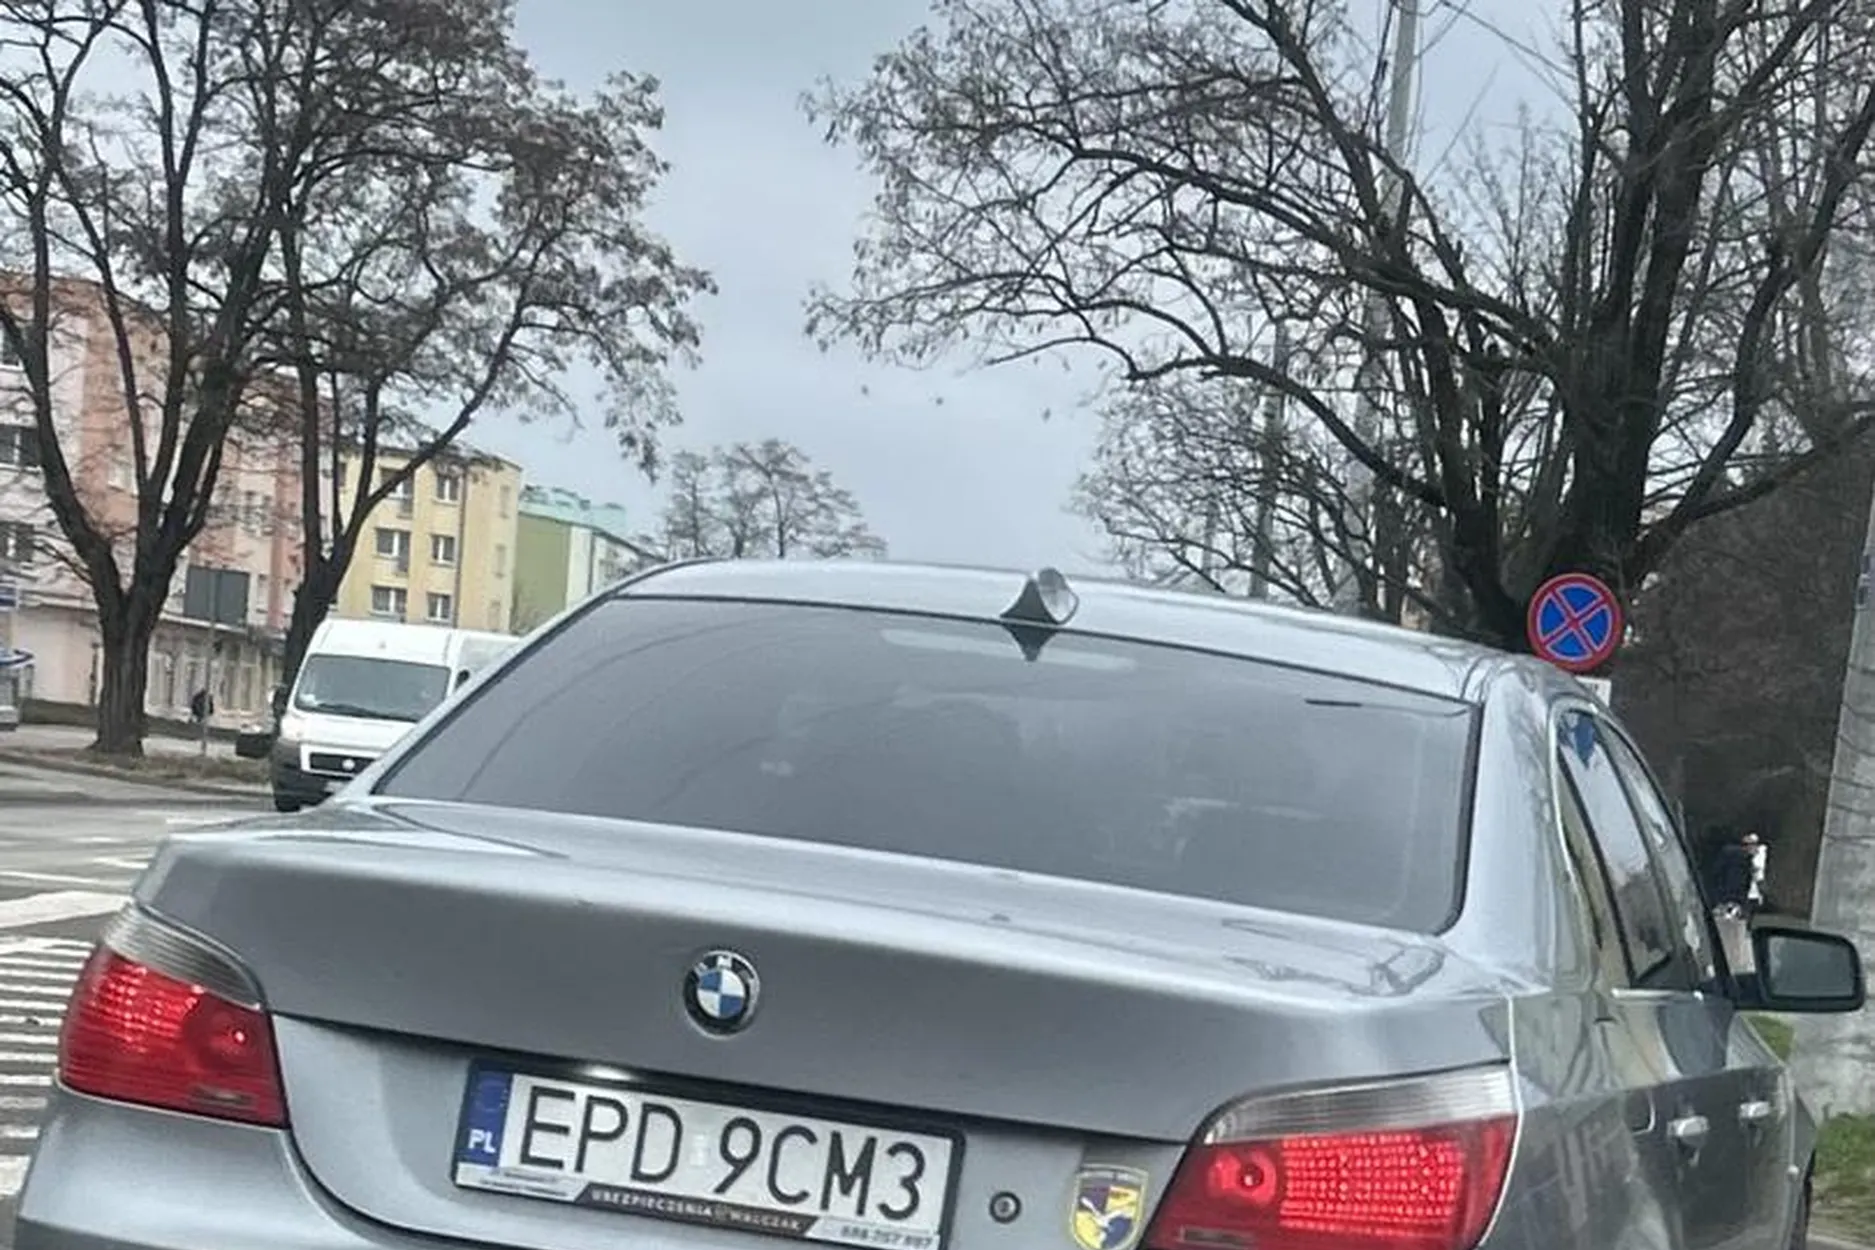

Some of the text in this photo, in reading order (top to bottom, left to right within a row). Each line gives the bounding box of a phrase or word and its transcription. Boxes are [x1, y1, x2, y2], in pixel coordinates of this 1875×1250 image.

[468, 1128, 496, 1154] PL
[520, 1085, 926, 1221] EPD 9CM3
